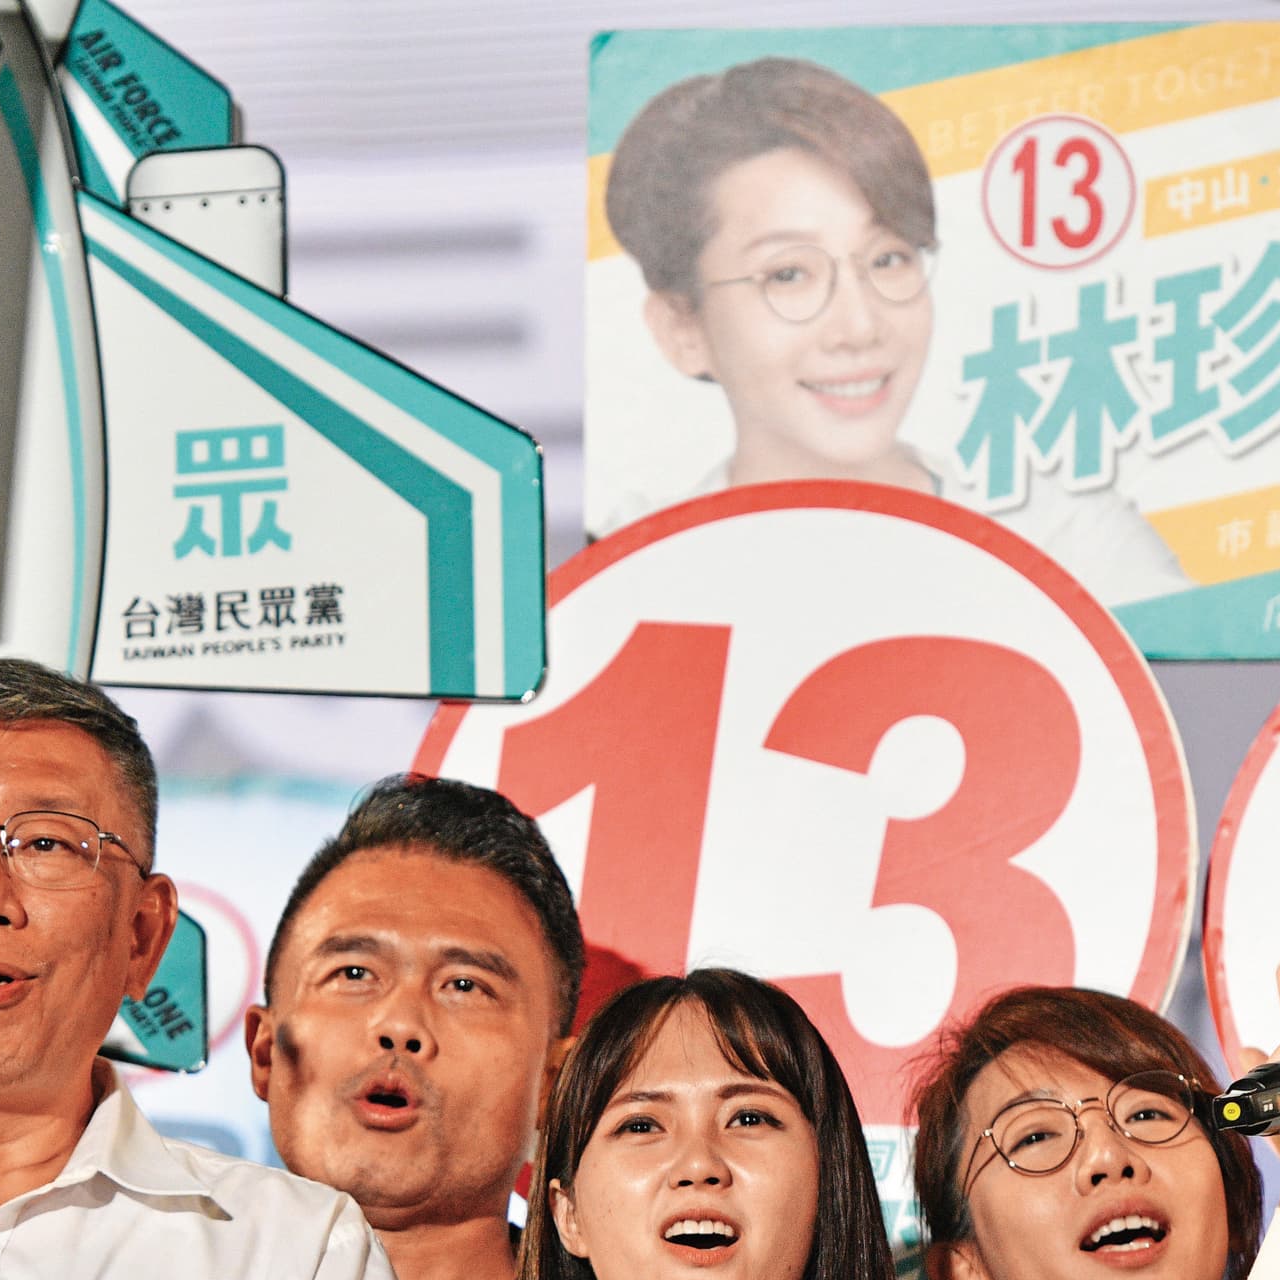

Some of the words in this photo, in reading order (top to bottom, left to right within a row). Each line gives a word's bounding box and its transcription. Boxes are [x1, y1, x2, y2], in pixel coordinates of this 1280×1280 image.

[78, 28, 125, 73] AIR
[112, 72, 182, 147] FORCE
[928, 84, 1106, 157] BETTER
[1012, 135, 1105, 250] 13
[173, 425, 292, 561] 眾
[123, 581, 345, 640] 台灣民眾黨
[123, 641, 195, 662] TAIWAN
[201, 634, 283, 656] PEOPLE'S
[288, 631, 347, 650] PARTY
[494, 620, 1082, 1128] 13
[144, 986, 194, 1041] ONE
